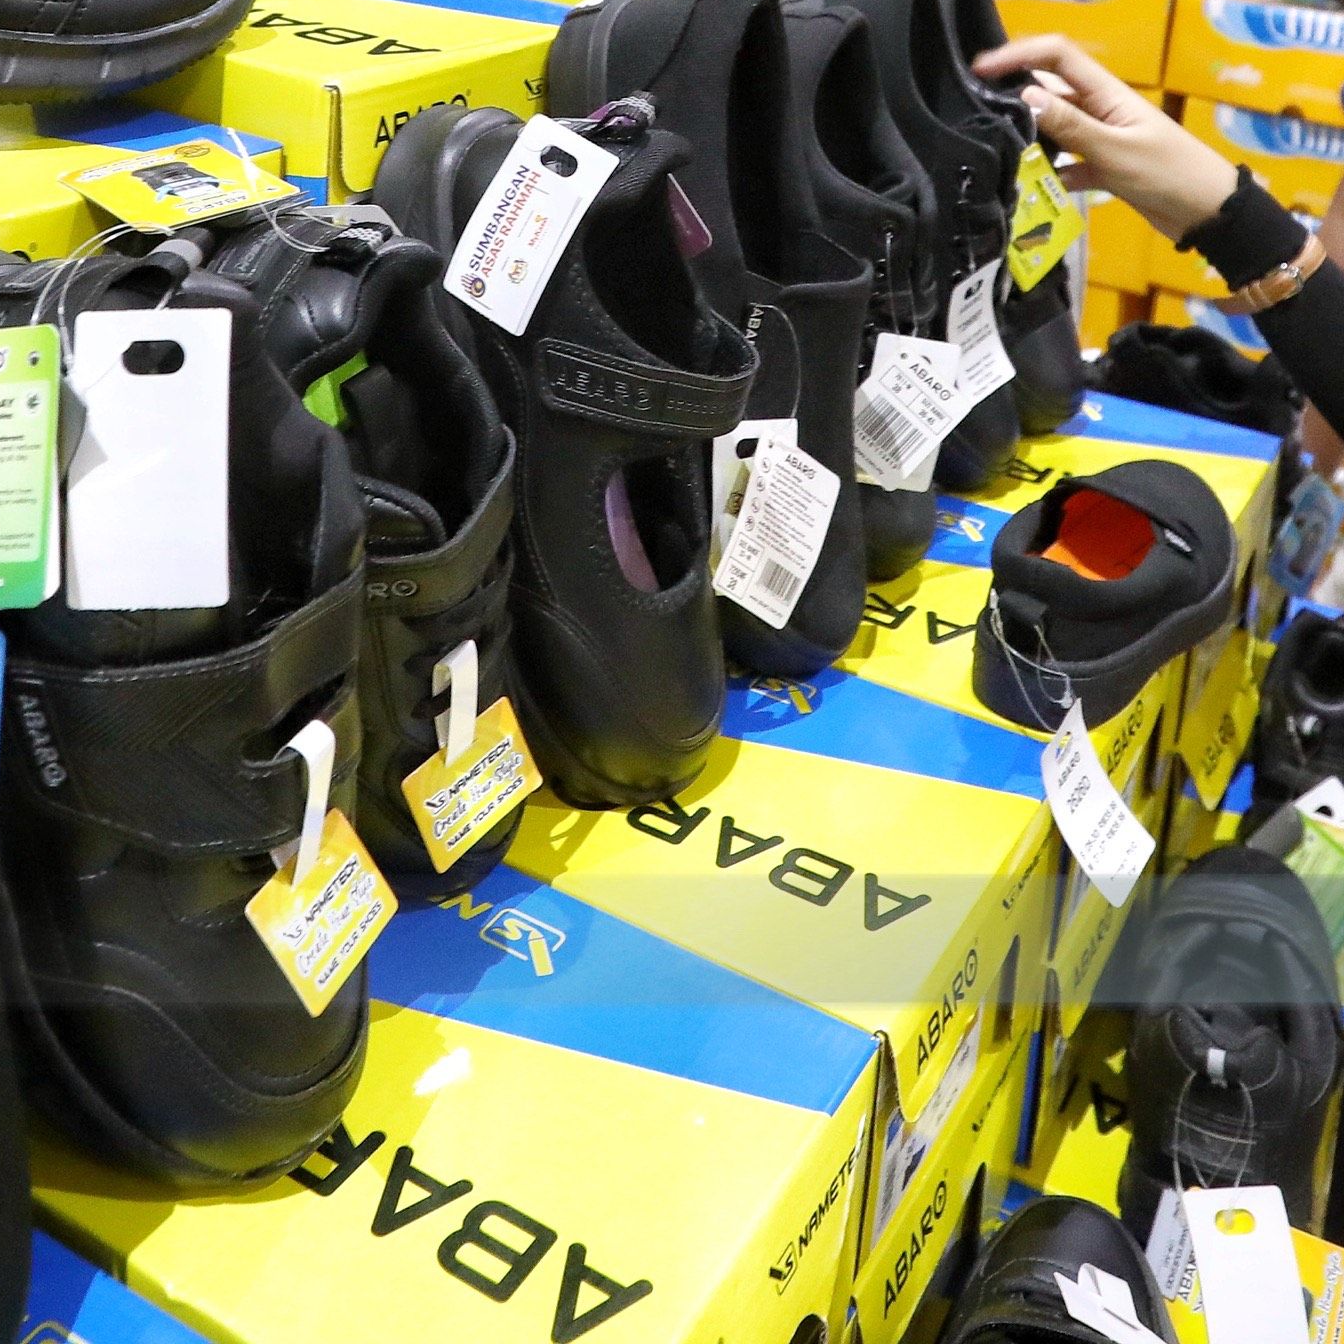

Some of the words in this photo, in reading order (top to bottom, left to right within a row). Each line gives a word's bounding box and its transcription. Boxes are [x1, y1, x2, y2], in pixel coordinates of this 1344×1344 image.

[468, 164, 531, 272] SUMBANGAN
[480, 235, 505, 278] ASAS
[500, 171, 542, 237] RAHMAH
[909, 362, 952, 402] ABARO
[785, 454, 817, 481] ABARO
[19, 694, 68, 788] ABARO
[448, 738, 511, 800] NAMETECH
[447, 822, 472, 848] NAME
[473, 803, 496, 823] YOUR
[497, 776, 524, 804] SHOES
[305, 855, 359, 924] NAMETECH
[626, 801, 931, 932] ABAR
[318, 957, 340, 985] NAME
[340, 932, 360, 953] YOUR
[359, 901, 383, 932] SHOES
[916, 949, 977, 1076] ABARO
[290, 1121, 653, 1344] ABAR
[883, 1179, 946, 1320] ABARO
